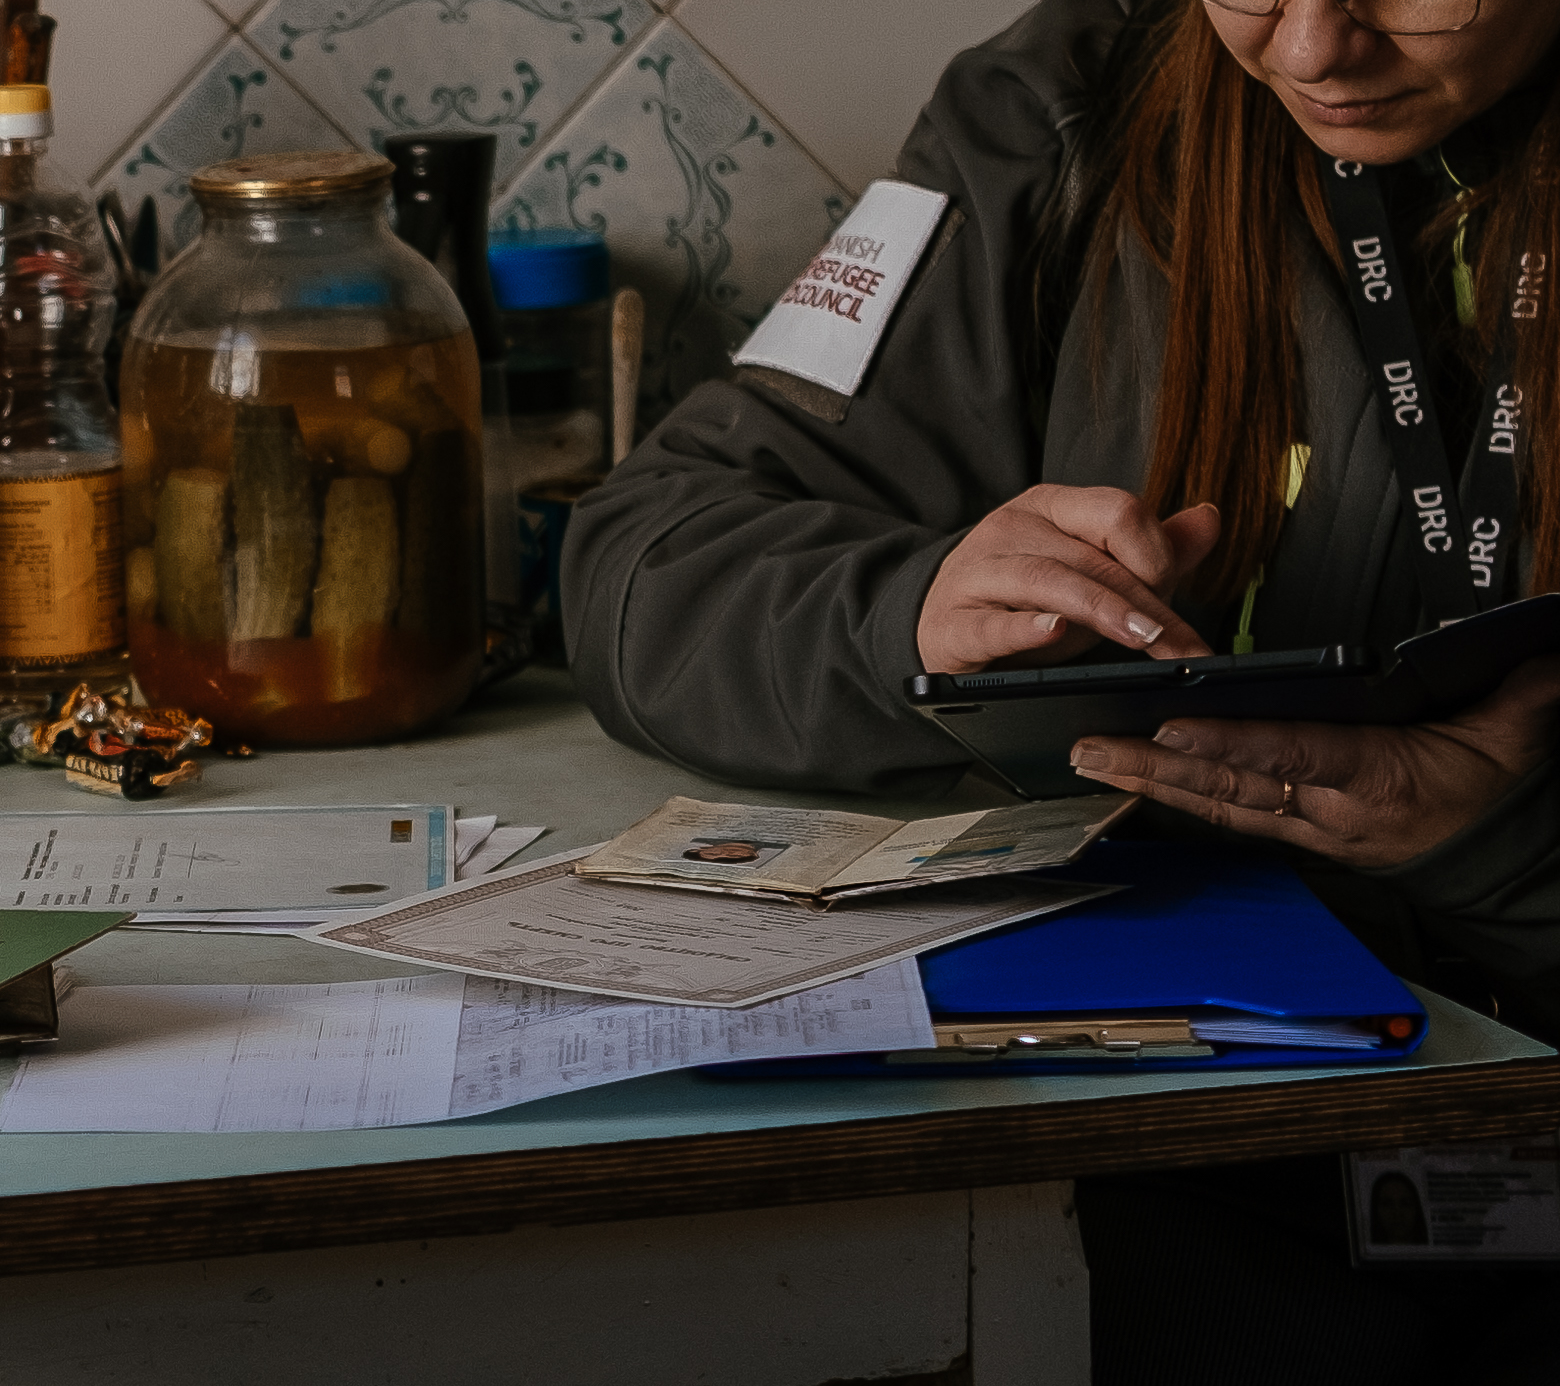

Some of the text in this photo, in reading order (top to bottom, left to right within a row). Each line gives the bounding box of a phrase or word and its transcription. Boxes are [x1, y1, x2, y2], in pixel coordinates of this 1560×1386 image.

[832, 235, 885, 263] ANISH
[1352, 236, 1392, 303] DRC
[1511, 252, 1546, 319] DRC
[1383, 359, 1423, 426] DRC
[1488, 384, 1523, 454] DRC
[1413, 485, 1452, 553] DRC
